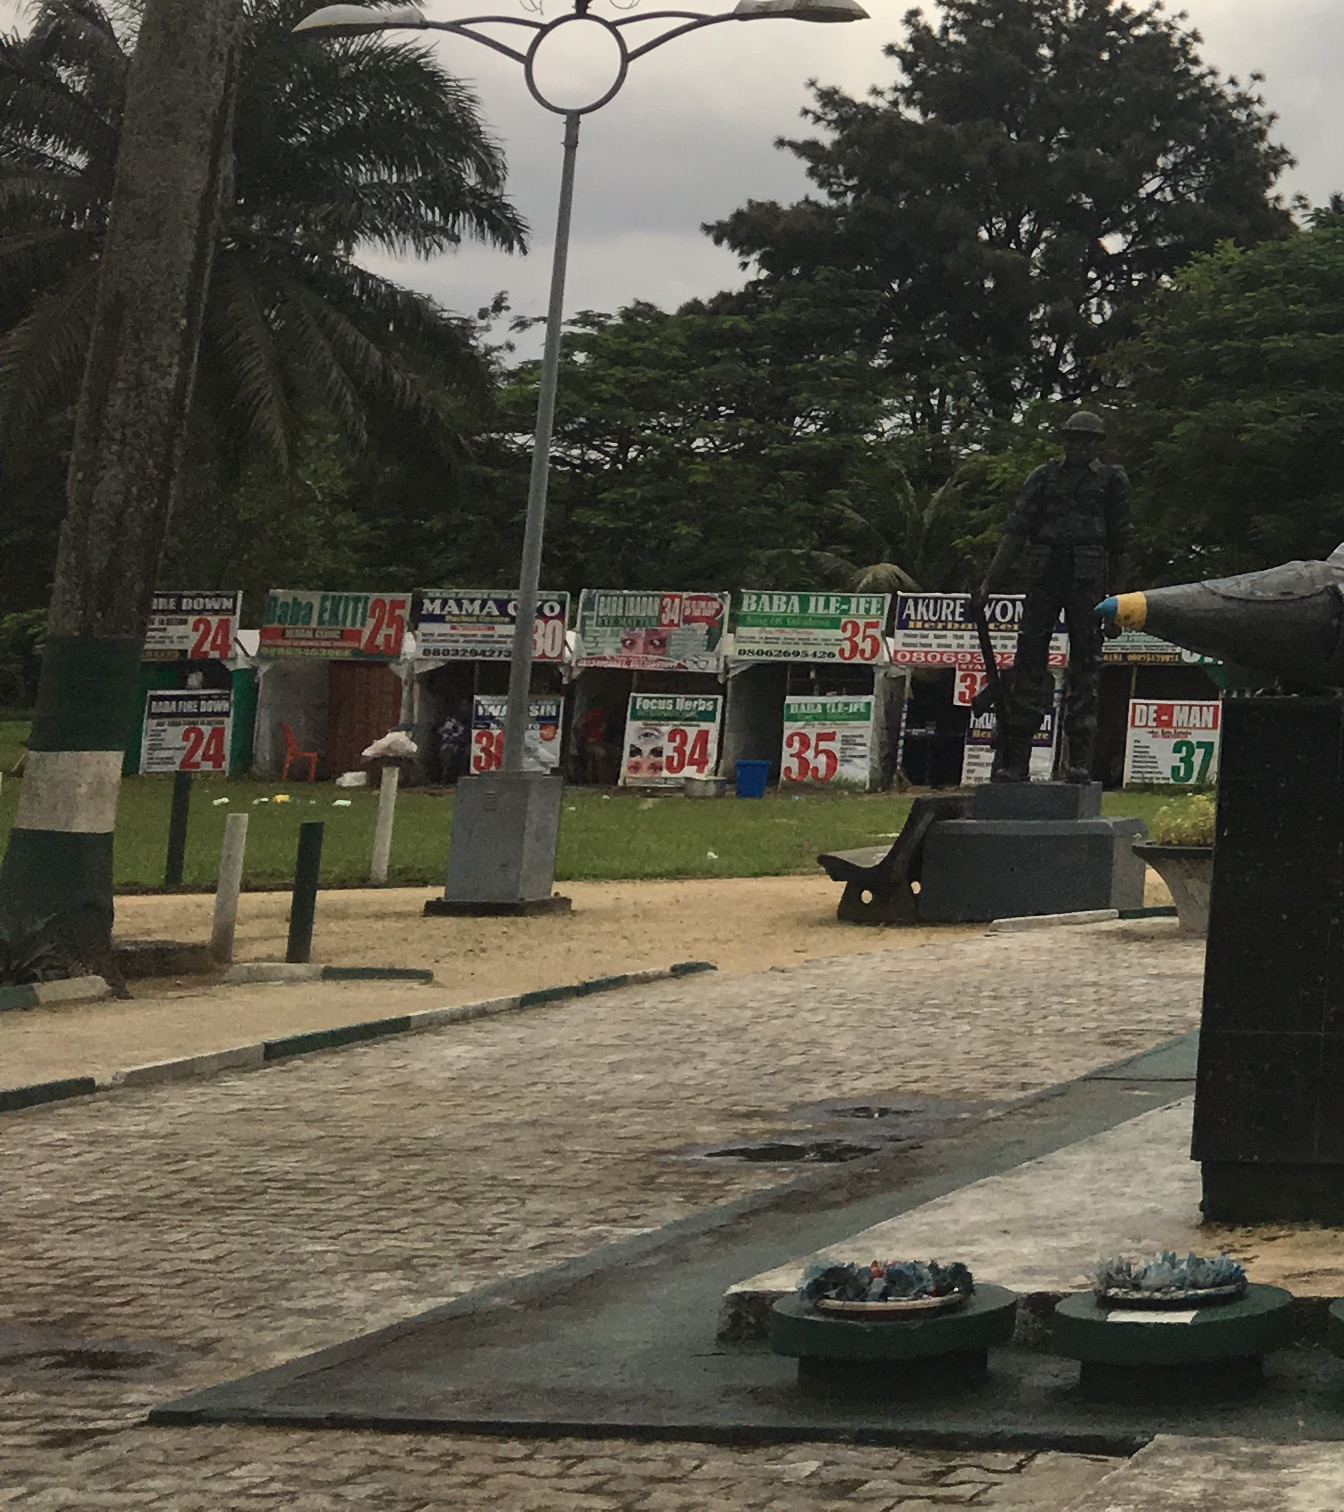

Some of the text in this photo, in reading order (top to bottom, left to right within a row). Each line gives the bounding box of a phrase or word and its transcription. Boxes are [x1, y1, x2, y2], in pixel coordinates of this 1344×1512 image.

[151, 597, 234, 610] IRE DOWN
[264, 593, 370, 628] Baba EKITI
[421, 598, 561, 617] MAMA OO
[661, 597, 681, 625] 34
[741, 594, 800, 613] BABA
[807, 595, 882, 616] ILE-IFE
[902, 598, 966, 622] AKURE
[190, 617, 232, 659] 24
[363, 597, 407, 656] 25
[531, 619, 564, 658] 30
[838, 620, 881, 661] 35
[200, 699, 230, 713] DOWN
[636, 697, 714, 712] Focus Herbs
[1134, 704, 1158, 727] DE
[1171, 705, 1215, 728] MAN
[179, 726, 225, 770] 24
[665, 727, 710, 775] 34
[783, 731, 838, 783] 35
[1170, 739, 1216, 784] 37
